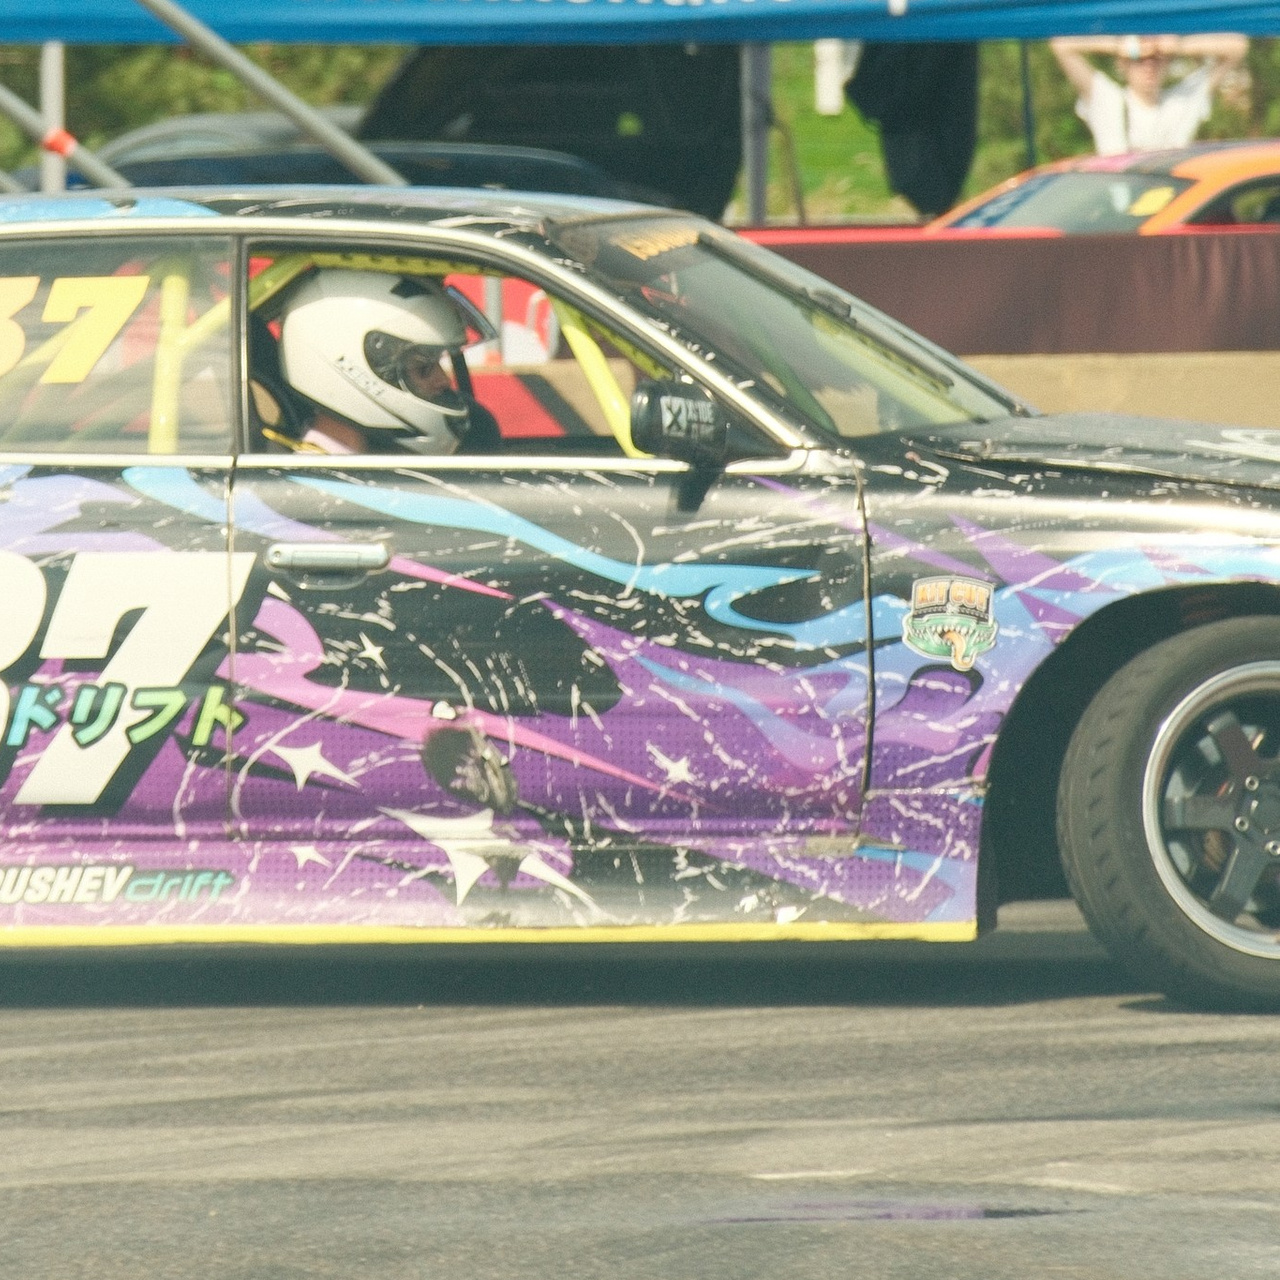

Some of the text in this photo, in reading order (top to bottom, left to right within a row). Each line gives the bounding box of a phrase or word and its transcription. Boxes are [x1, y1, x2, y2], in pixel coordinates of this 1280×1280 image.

[7, 683, 245, 746] ドリフト
[125, 871, 235, 902] drift
